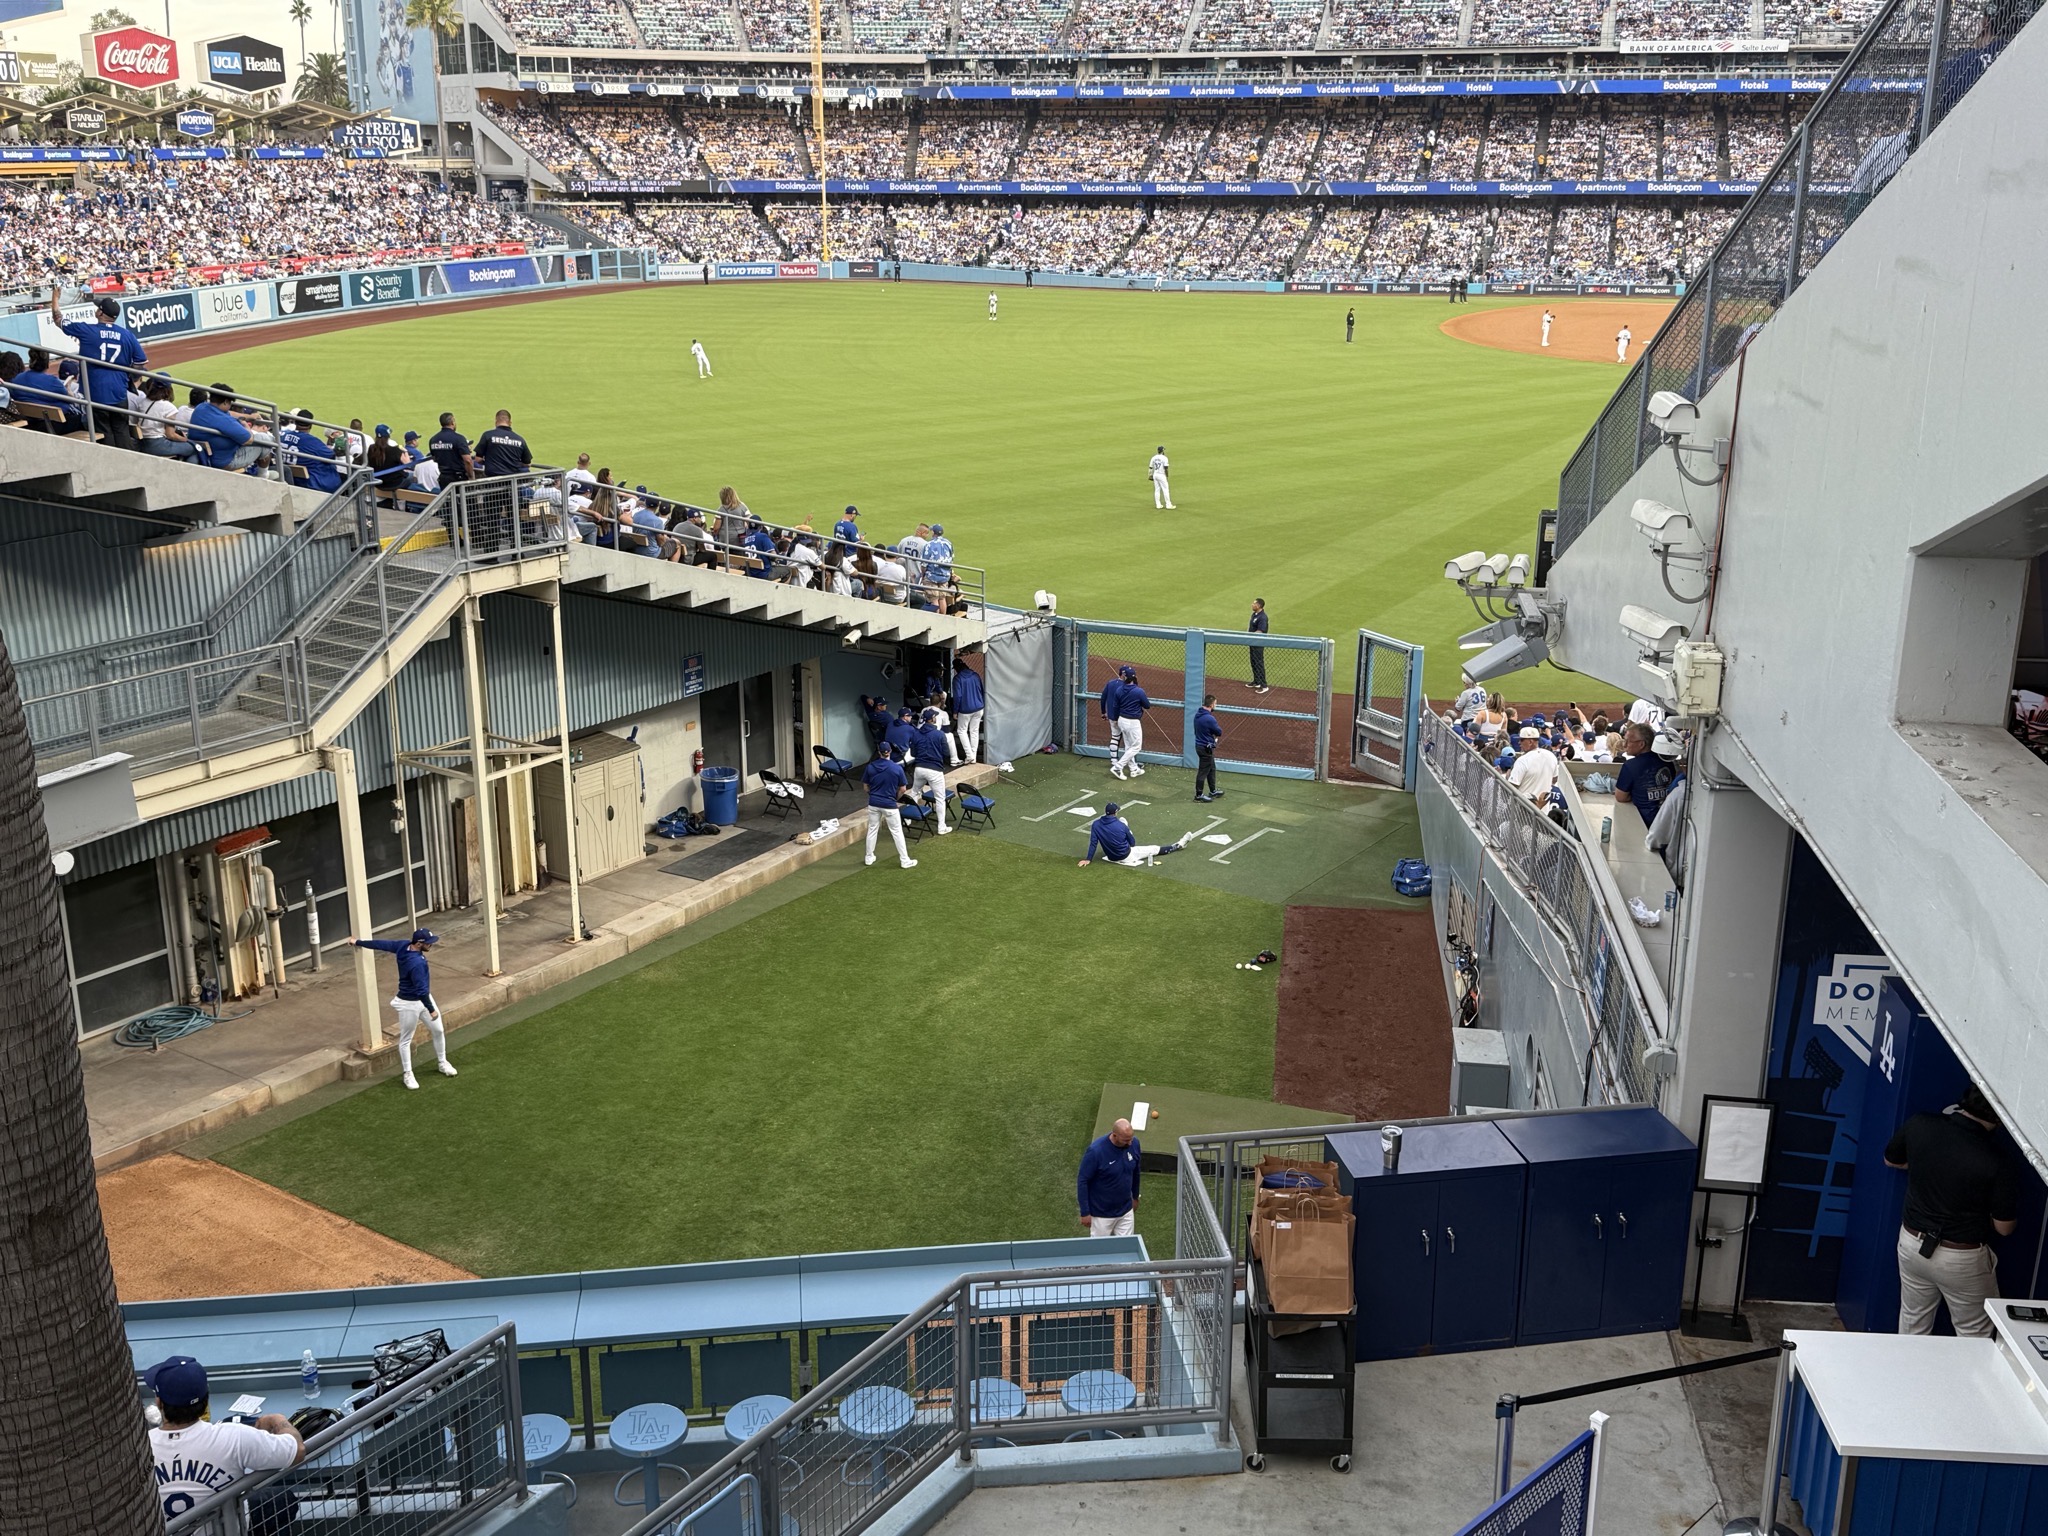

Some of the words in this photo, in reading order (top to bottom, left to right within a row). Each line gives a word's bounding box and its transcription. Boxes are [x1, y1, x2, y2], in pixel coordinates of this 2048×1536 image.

[104, 41, 172, 75] Coca-Cola
[213, 56, 241, 70] UCLA
[244, 56, 282, 72] Health
[552, 83, 570, 91] 1955
[1316, 85, 1350, 94] Vacation
[1352, 85, 1380, 93] rentals
[1394, 84, 1444, 94] Booking.com
[1466, 83, 1493, 92] Hotels
[1663, 80, 1717, 91] Booking.com
[1740, 80, 1769, 90] Hotels
[827, 88, 844, 96] 1988
[1011, 87, 1058, 97] Booking.com
[1080, 87, 1104, 96] Hotels
[1123, 87, 1170, 97] Booking.com
[1190, 86, 1235, 96] Apartments
[1254, 86, 1302, 96] Booking.com
[70, 113, 104, 122] STARLUX
[180, 115, 213, 125] MORTON
[570, 182, 586, 191] 5:55
[775, 182, 823, 192] Booking.com
[844, 182, 870, 191] Hotels
[889, 182, 937, 192] Booking.com
[957, 183, 1003, 193] Apartments
[1020, 183, 1068, 193] Booking.com
[1081, 184, 1115, 192] Vacation
[1116, 184, 1142, 192] rentals
[1156, 184, 1204, 194] Booking.com
[1225, 184, 1251, 192] Hotels
[1376, 184, 1427, 194] Booking.com
[1450, 183, 1478, 192] Hotels
[1499, 183, 1552, 194] Booking.com
[1575, 183, 1626, 193] Apartments
[1648, 183, 1702, 194] Booking.com
[1718, 183, 1757, 192] Vacation
[567, 263, 574, 273] 76
[781, 266, 817, 275] Yakult
[375, 273, 402, 287] Security
[469, 268, 516, 283] Booking.com
[305, 284, 340, 296] smartwater
[377, 288, 401, 300] Benefit
[213, 292, 243, 312] blue
[280, 292, 296, 302] smart
[126, 302, 185, 332] Spectrum
[219, 312, 248, 323] california
[100, 330, 121, 340] OHTANI
[100, 342, 121, 363] 17
[284, 434, 300, 444] BETTS
[491, 436, 522, 447] SECURITY
[431, 441, 453, 449] SECURITY
[904, 548, 919, 558] 50
[1472, 691, 1486, 704] 36
[1648, 710, 1658, 723] 17
[1829, 982, 1875, 1001] DO
[1826, 1006, 1878, 1022] MEM
[154, 1453, 234, 1493] NÁNDEZ
